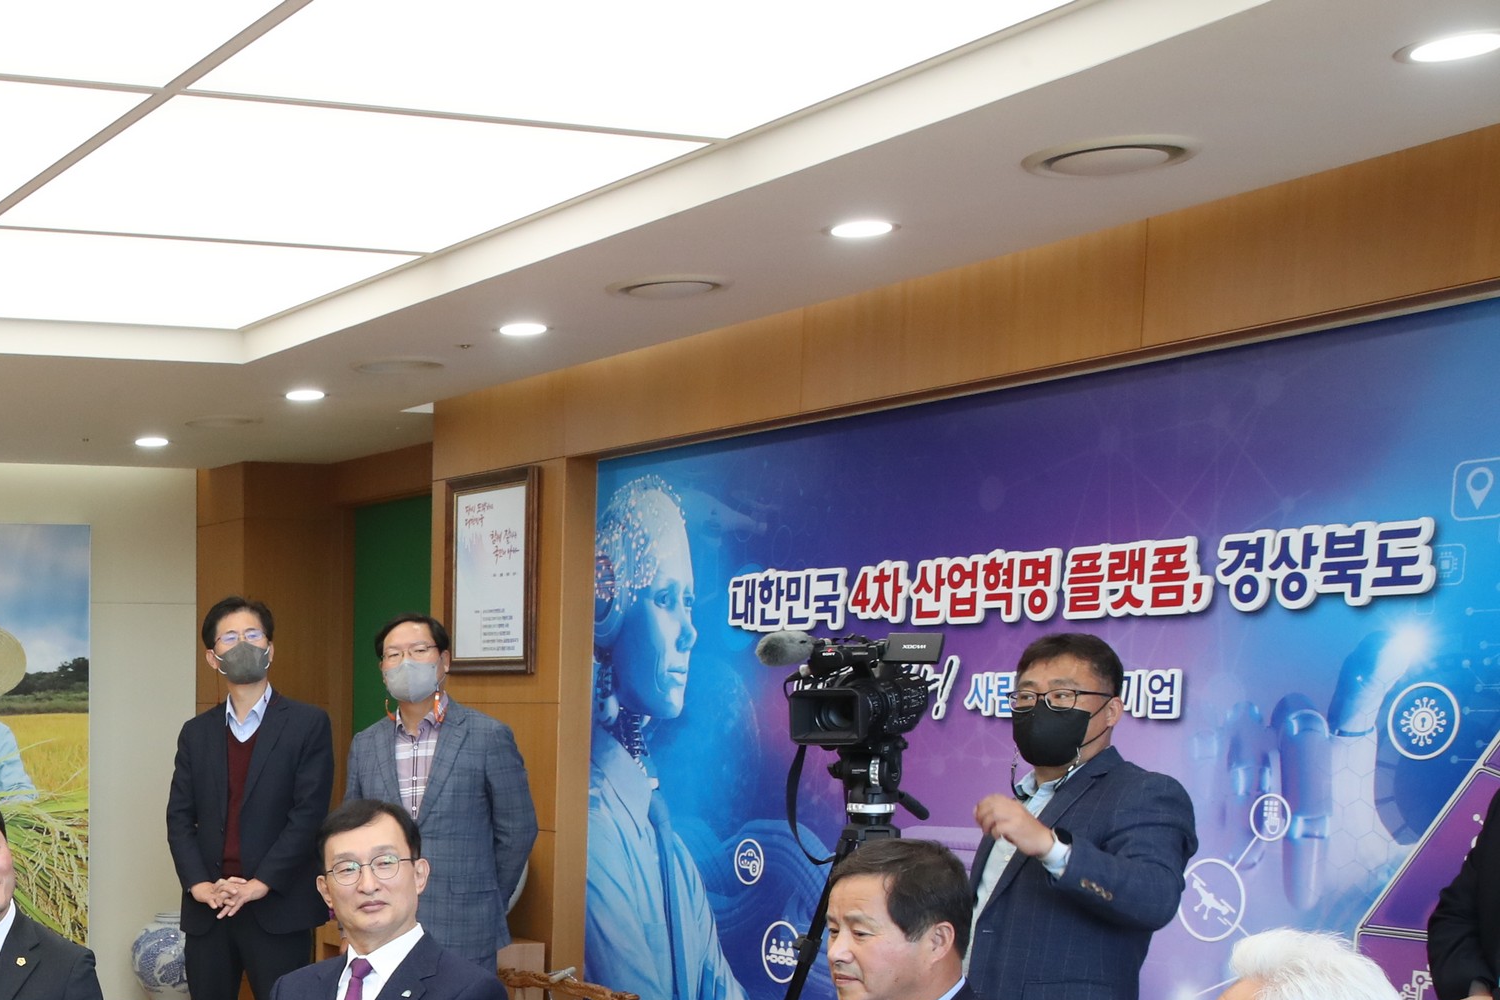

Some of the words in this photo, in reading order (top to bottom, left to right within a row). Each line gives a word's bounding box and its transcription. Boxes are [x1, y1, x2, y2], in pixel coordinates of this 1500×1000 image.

[729, 569, 846, 631] 대한민국
[850, 561, 908, 621] 4차
[913, 551, 1058, 622] 산업혁명
[1065, 540, 1209, 616] 플랫폼,
[1219, 521, 1431, 608] 경상북도
